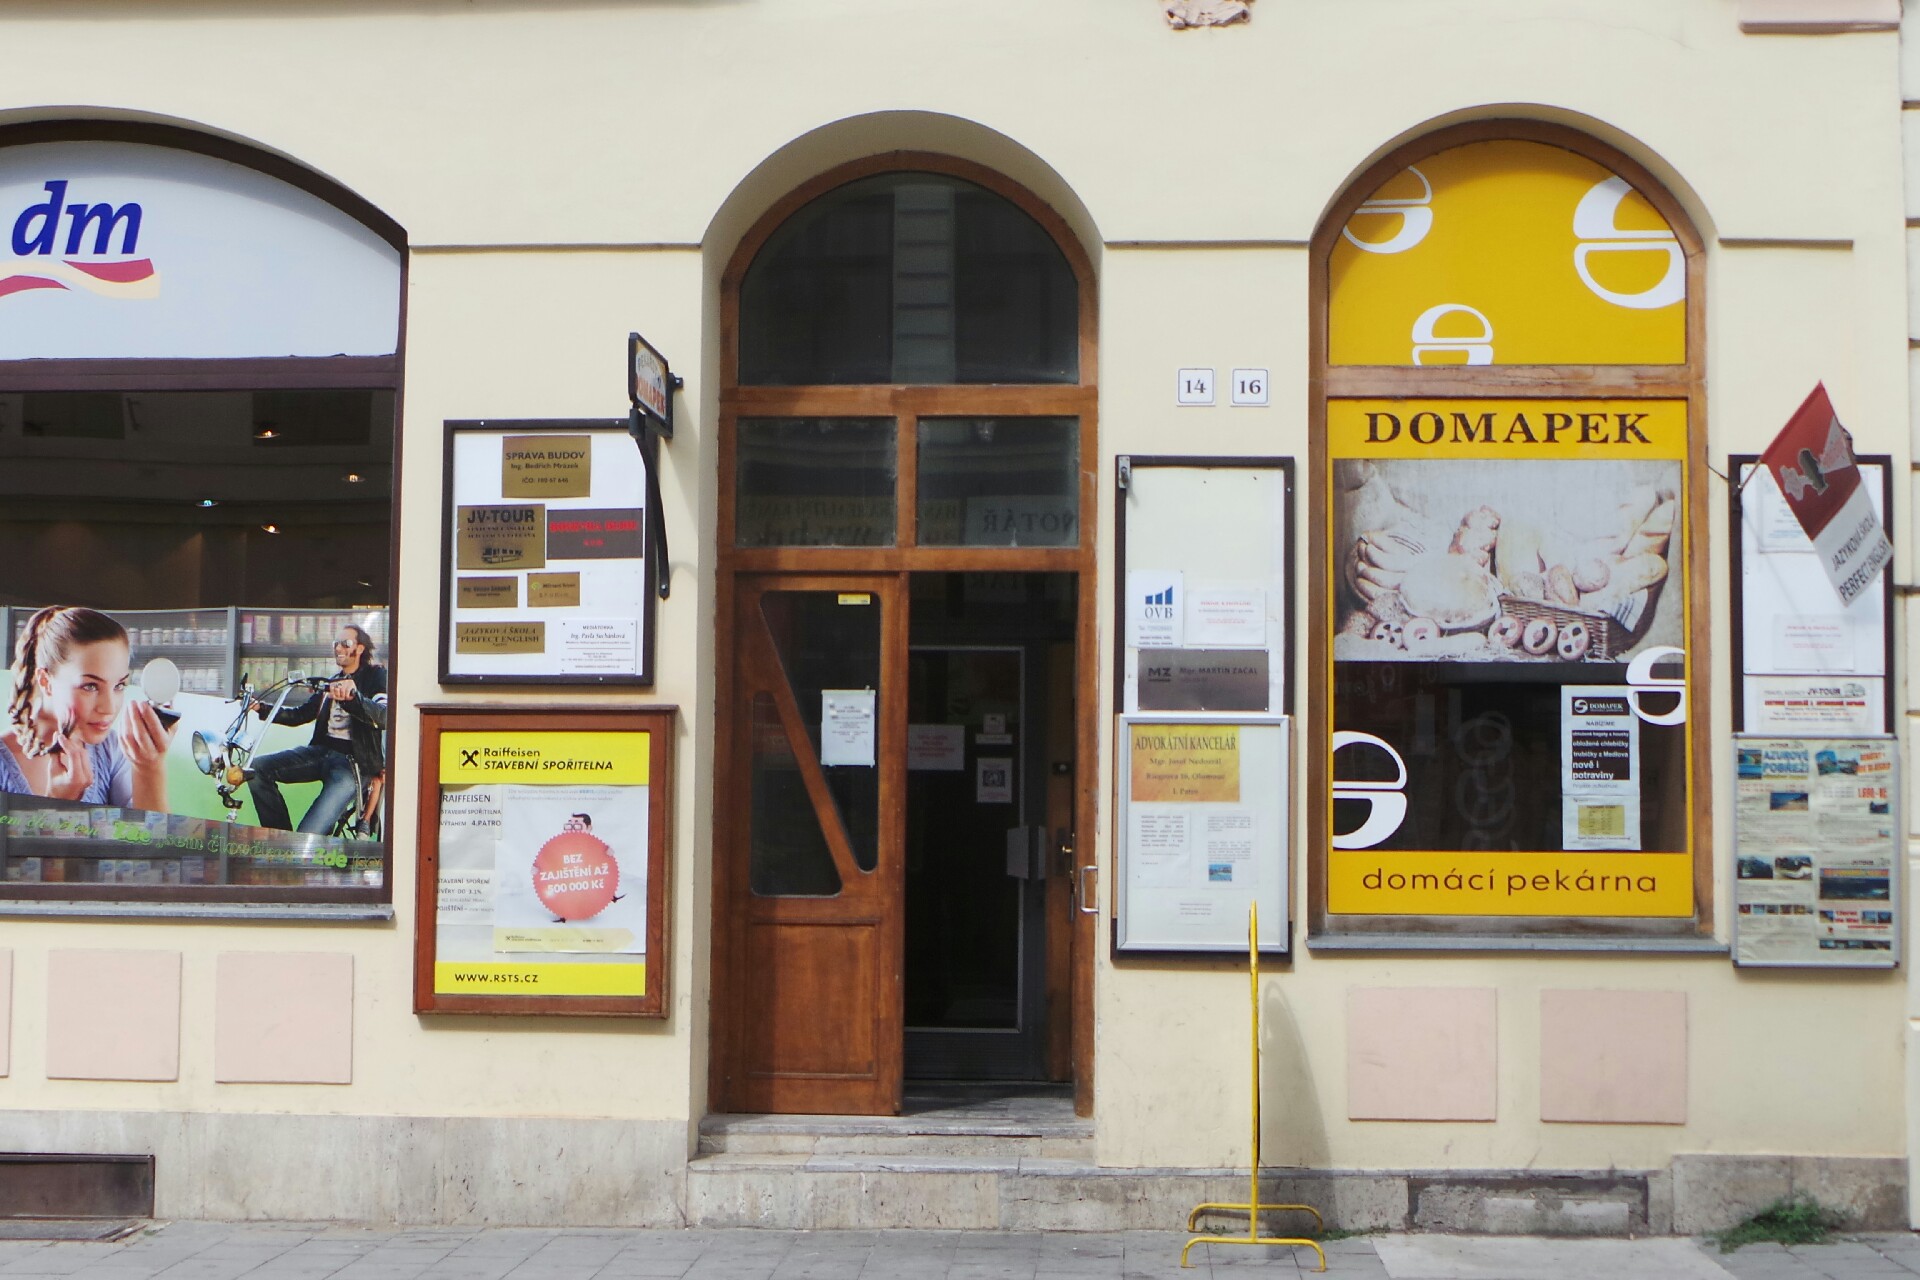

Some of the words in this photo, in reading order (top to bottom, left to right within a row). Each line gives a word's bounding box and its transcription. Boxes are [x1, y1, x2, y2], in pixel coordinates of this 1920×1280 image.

[12, 180, 142, 256] dm
[1185, 380, 1206, 394] 14
[1240, 380, 1261, 394] 16
[1364, 412, 1652, 444] DOMAPEK
[548, 452, 585, 460] BUDOV
[467, 509, 535, 524] JV-TOUR
[1839, 561, 1869, 600] PERFECT
[1145, 607, 1173, 619] OVB
[1135, 733, 1188, 750] ADVOKÁTNÍ
[1190, 733, 1236, 750] KANCELÁŘ
[484, 748, 540, 757] Raiffeisen
[484, 759, 538, 770] STAVEBNÍ
[543, 759, 613, 771] SPOŘITELNA
[1573, 760, 1594, 769] nově
[1573, 771, 1614, 780] potraviny
[443, 794, 490, 803] RAIFFEISEN
[312, 847, 347, 868] Zde
[563, 854, 583, 864] BEZ
[540, 866, 592, 881] ZAJIŠTĚNÍ
[594, 863, 609, 876] AŽ
[568, 882, 589, 893] 000
[591, 880, 604, 889] Kč
[1362, 868, 1495, 891] domácí
[1507, 869, 1657, 896] pekárna
[455, 973, 538, 983] WWW.RSTS.CZ
